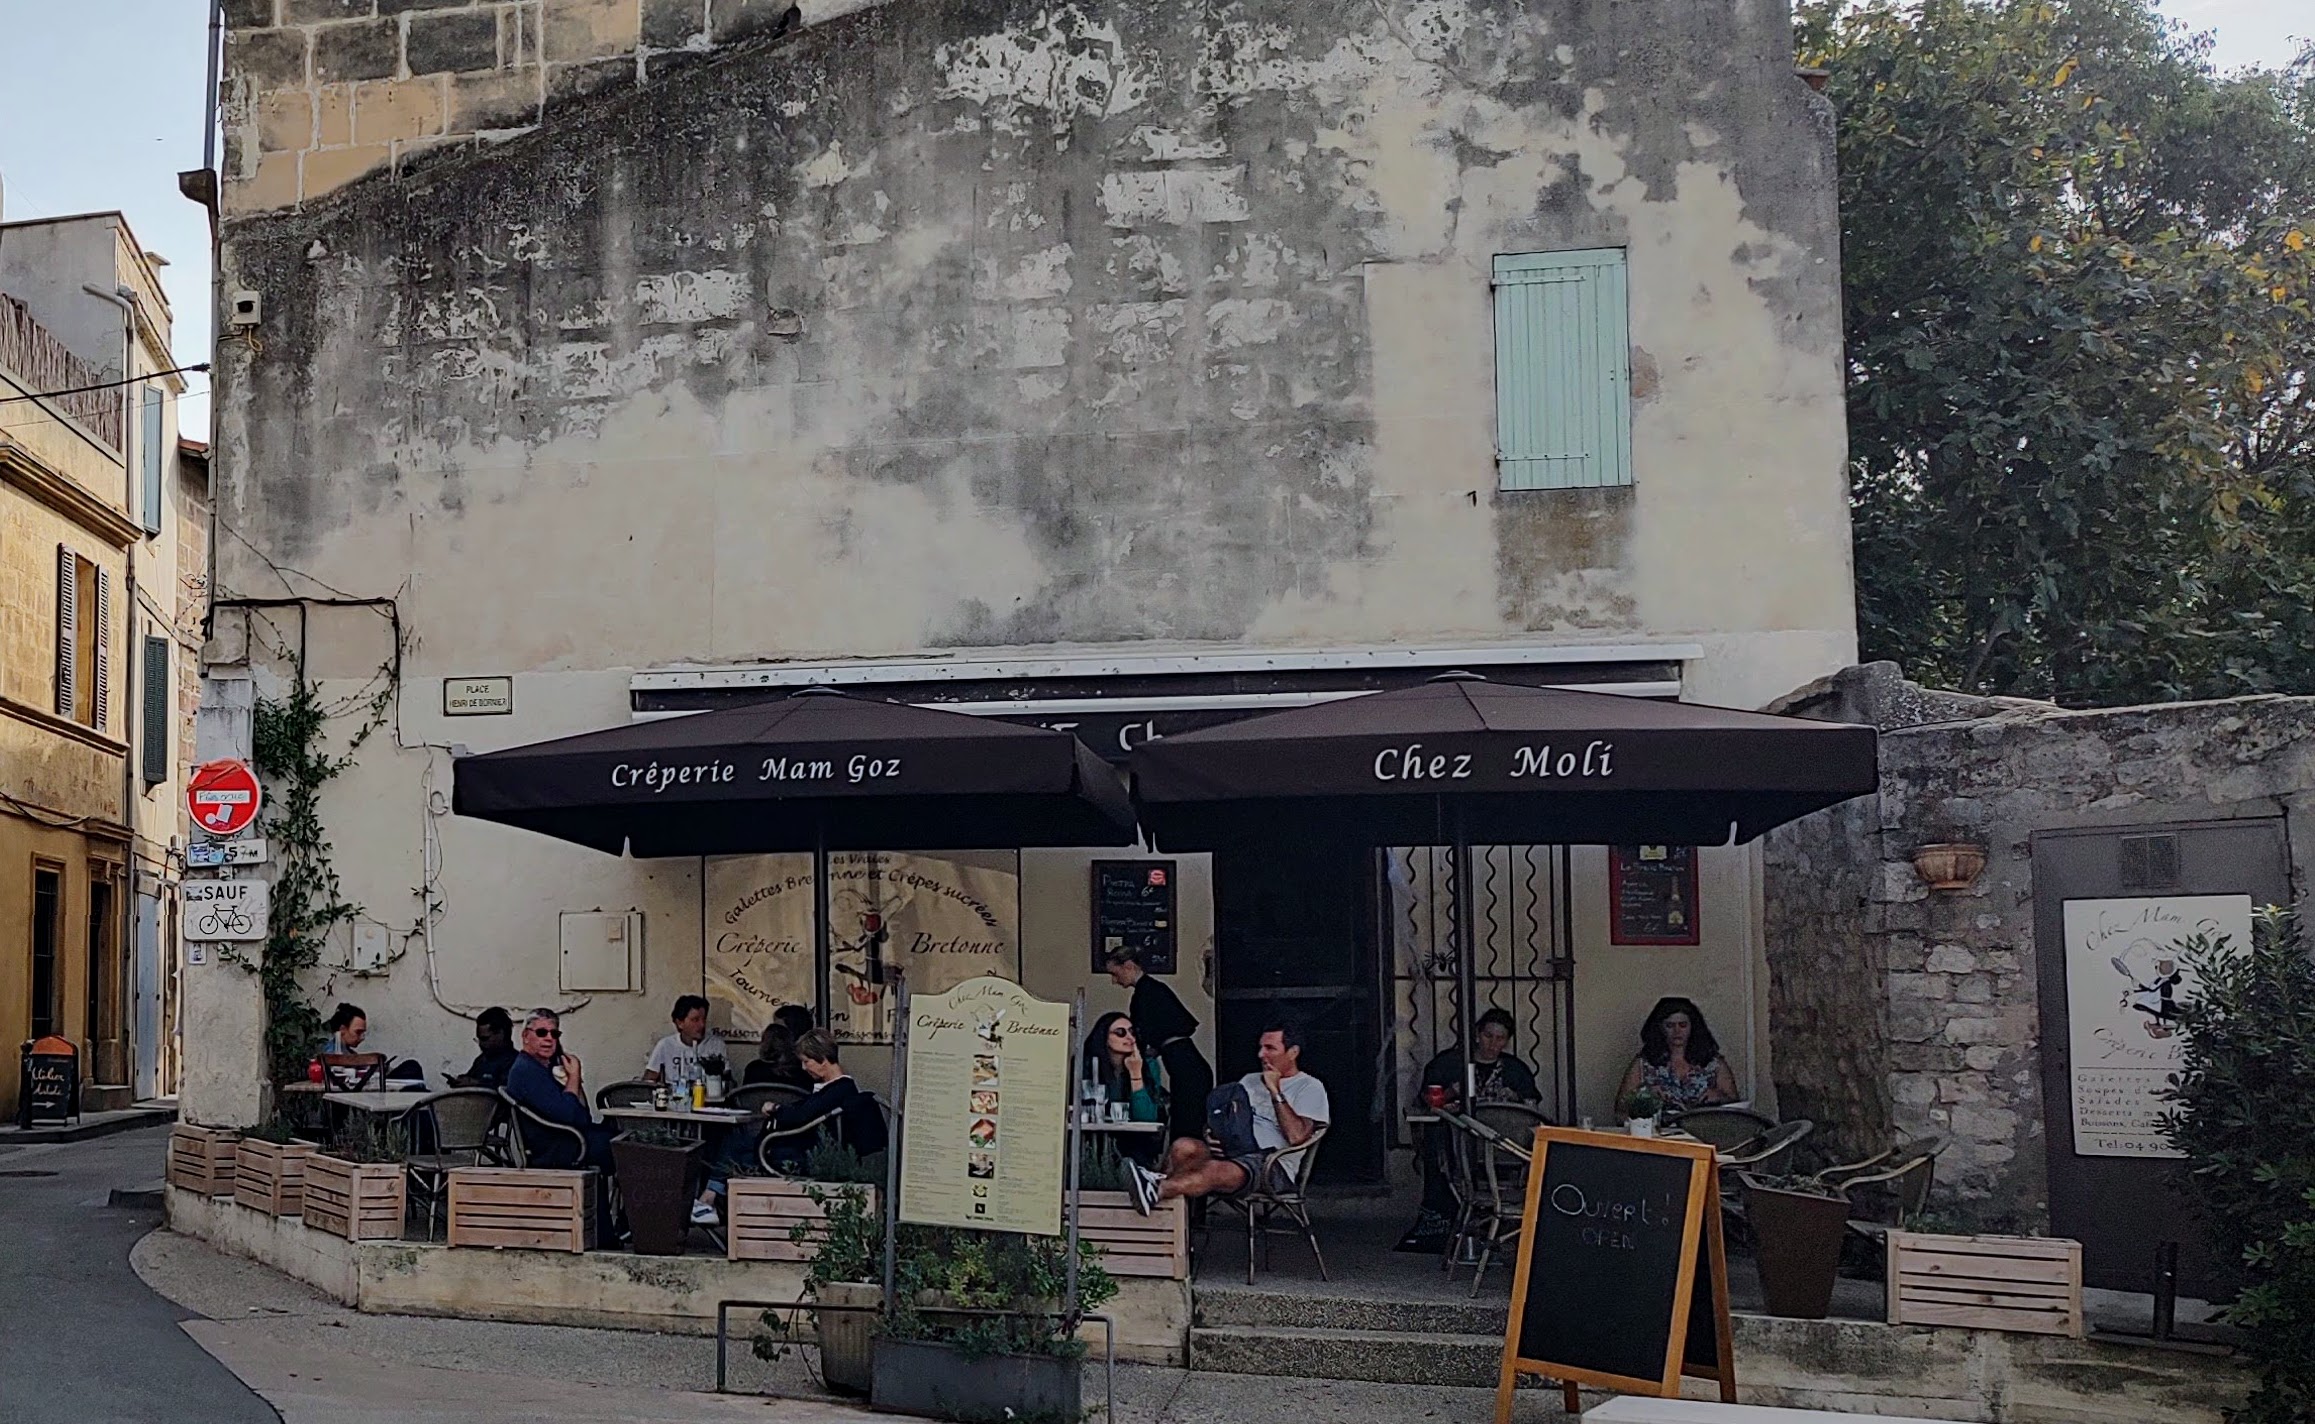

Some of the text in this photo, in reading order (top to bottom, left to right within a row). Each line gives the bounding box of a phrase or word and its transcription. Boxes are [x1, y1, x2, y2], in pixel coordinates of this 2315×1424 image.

[465, 684, 490, 694] PLACE
[1374, 740, 1614, 781] Chez Moli
[611, 754, 901, 794] Crêperie Mam Goz
[203, 885, 248, 900] SAUF
[724, 883, 784, 925] Galettes
[942, 885, 999, 928] sucrées
[716, 930, 1006, 967] Crêperie Bretonne
[916, 1014, 966, 1041] Crêperie
[1006, 1020, 1060, 1037] Bretonne
[2077, 1073, 2151, 1084] Galettes
[2077, 1085, 2124, 1097] Soupes
[2078, 1096, 2141, 1106] Salades
[2079, 1106, 2133, 1117] Desserts
